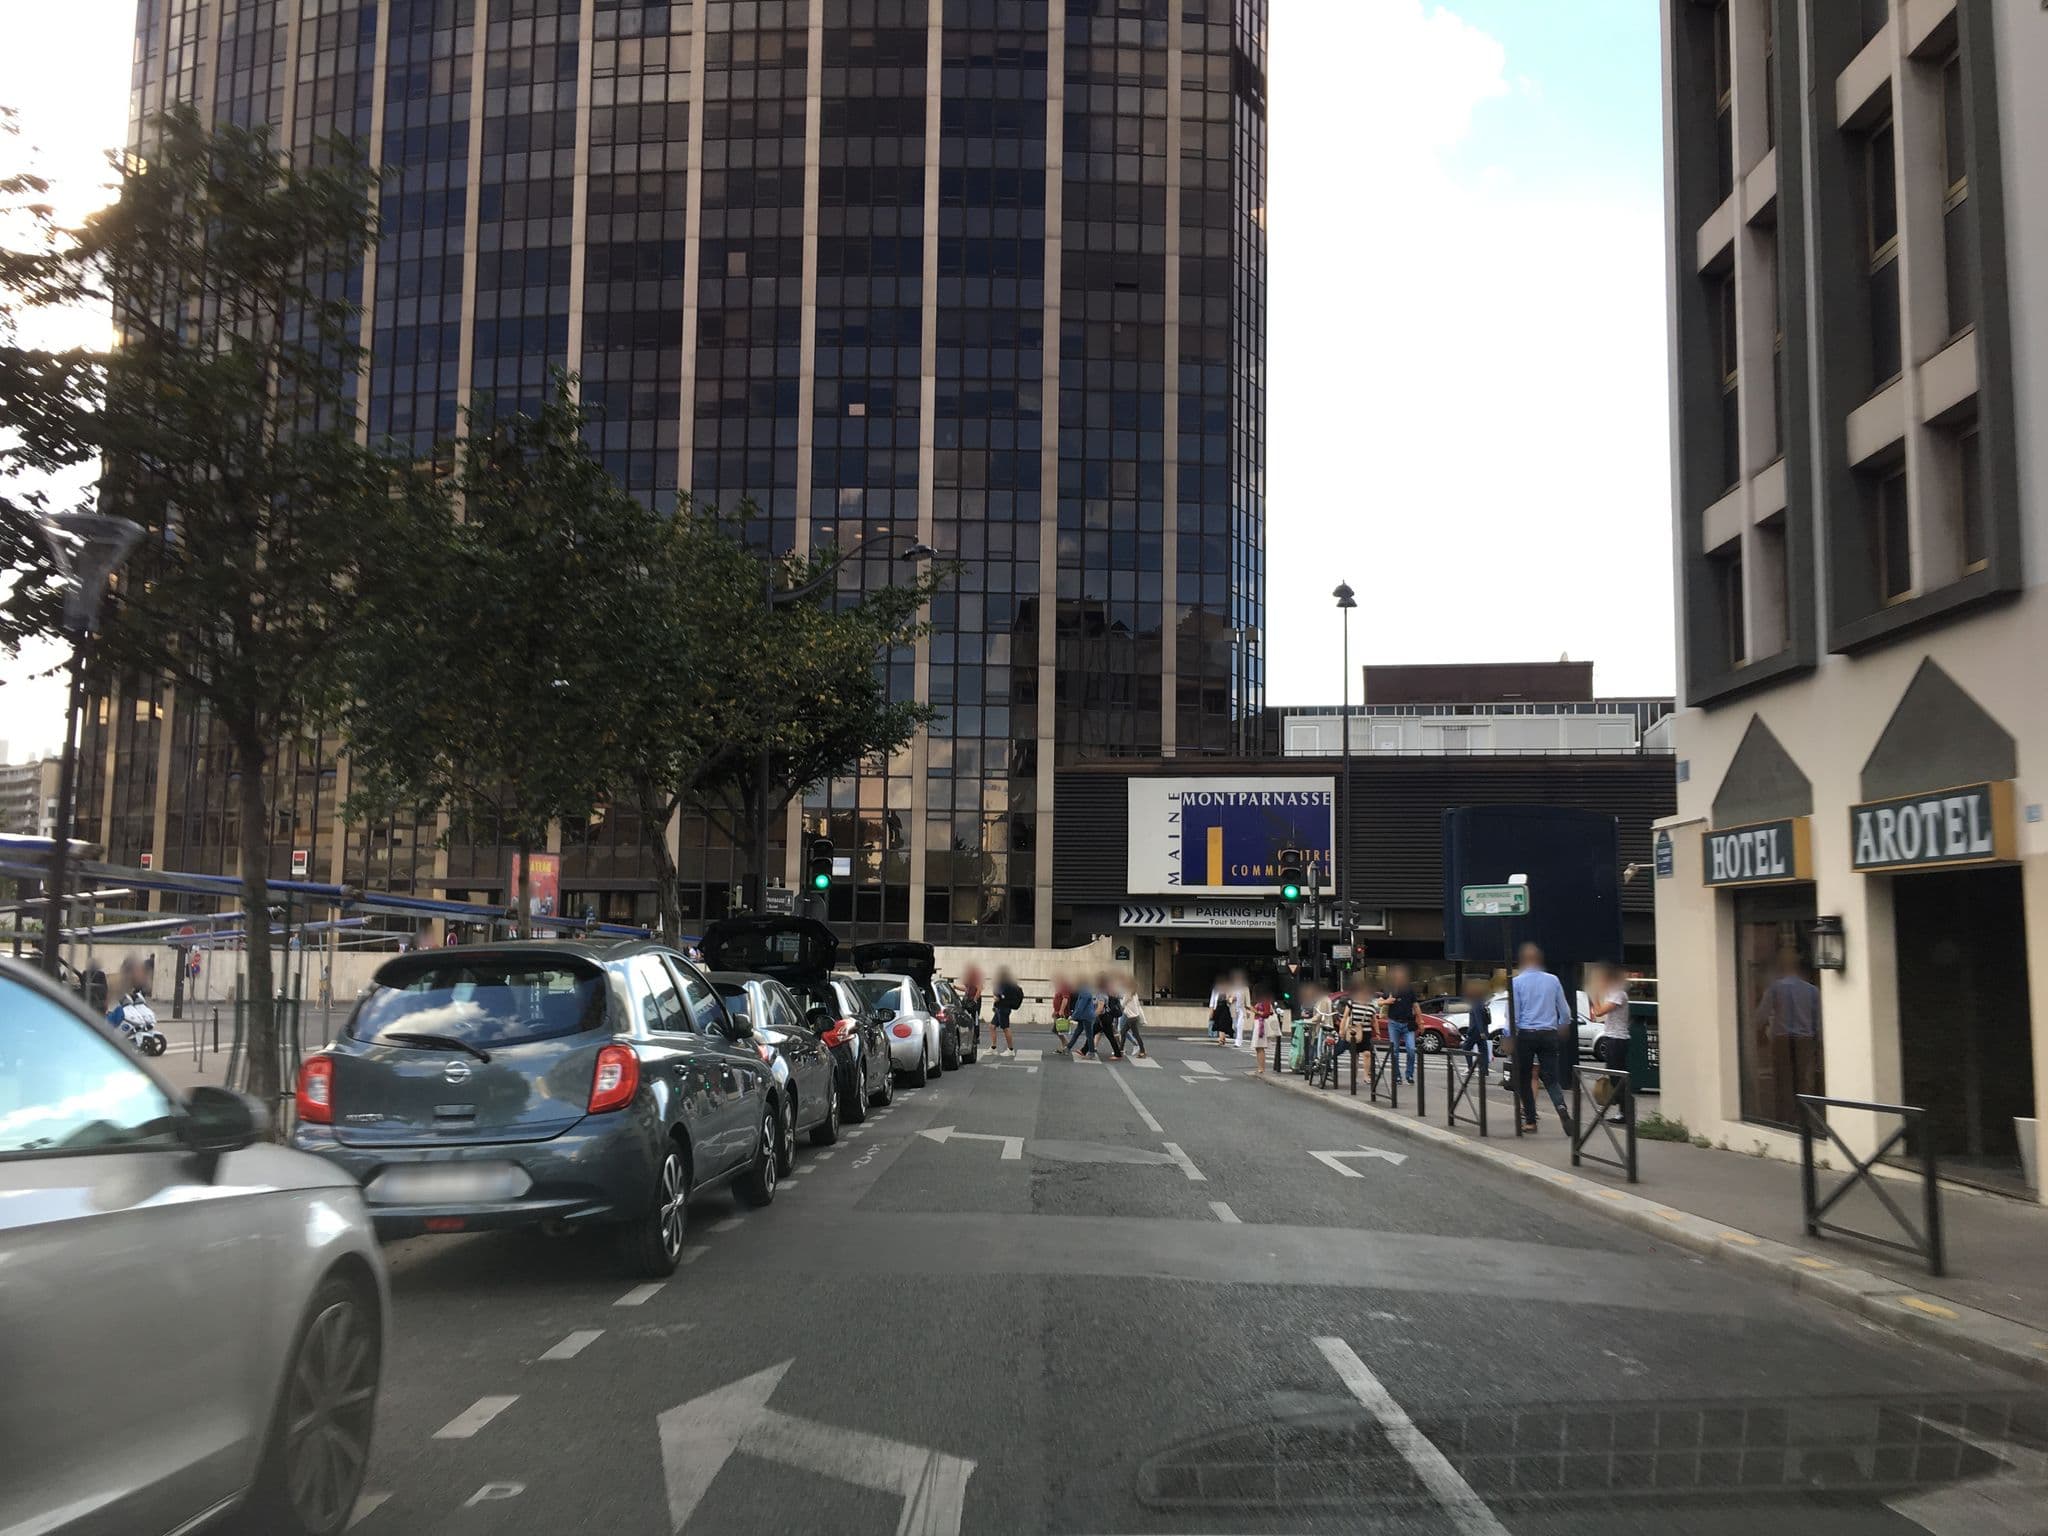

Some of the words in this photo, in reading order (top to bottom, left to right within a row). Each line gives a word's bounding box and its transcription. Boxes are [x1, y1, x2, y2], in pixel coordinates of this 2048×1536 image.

[1182, 792, 1331, 807] MONTPARNASSE
[1168, 792, 1180, 886] MAINE
[1855, 794, 1993, 864] AROTEL
[1711, 828, 1785, 880] HOTEL
[1196, 907, 1251, 917] PARKING
[1230, 918, 1276, 927] Montparnas
